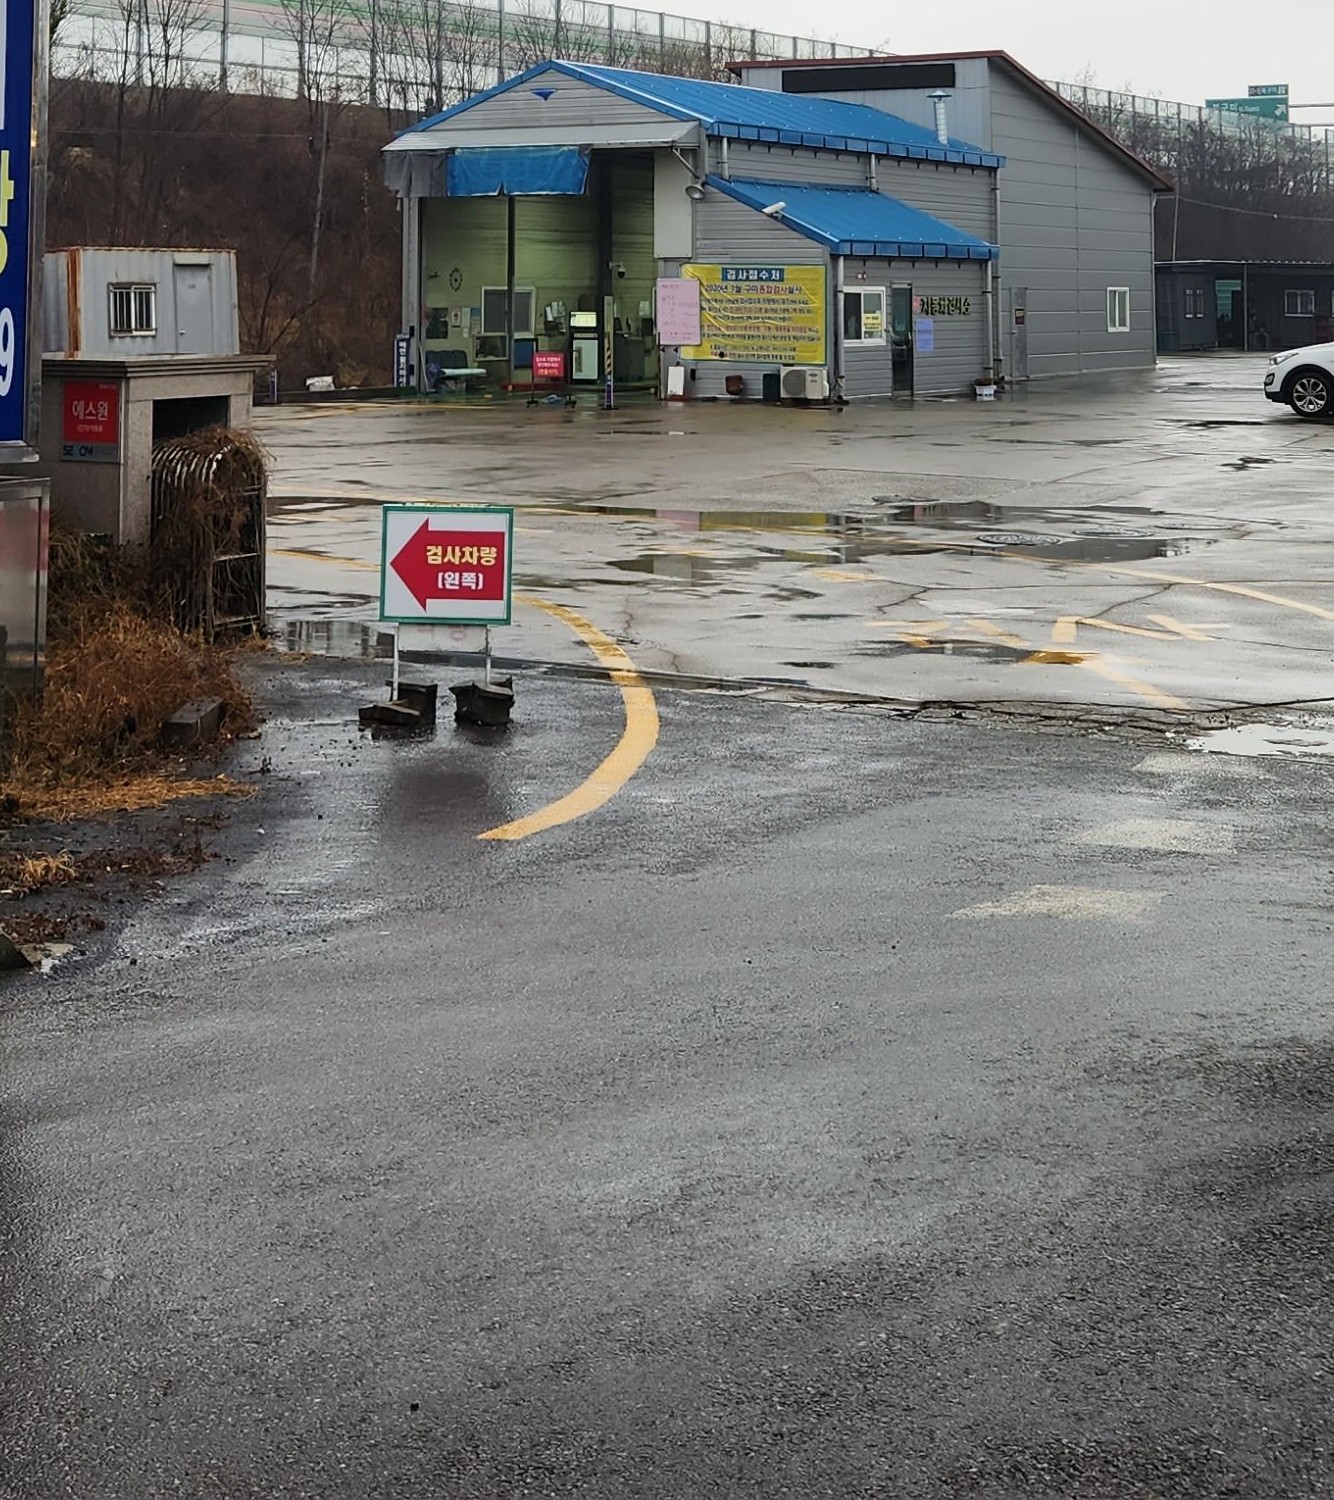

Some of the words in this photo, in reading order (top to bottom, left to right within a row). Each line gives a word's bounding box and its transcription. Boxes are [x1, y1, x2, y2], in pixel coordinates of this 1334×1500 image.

[727, 269, 780, 281] 검사접수처
[72, 400, 108, 420] 에스원
[426, 545, 498, 566] 검사차량
[437, 571, 484, 590] (왼쪽)
